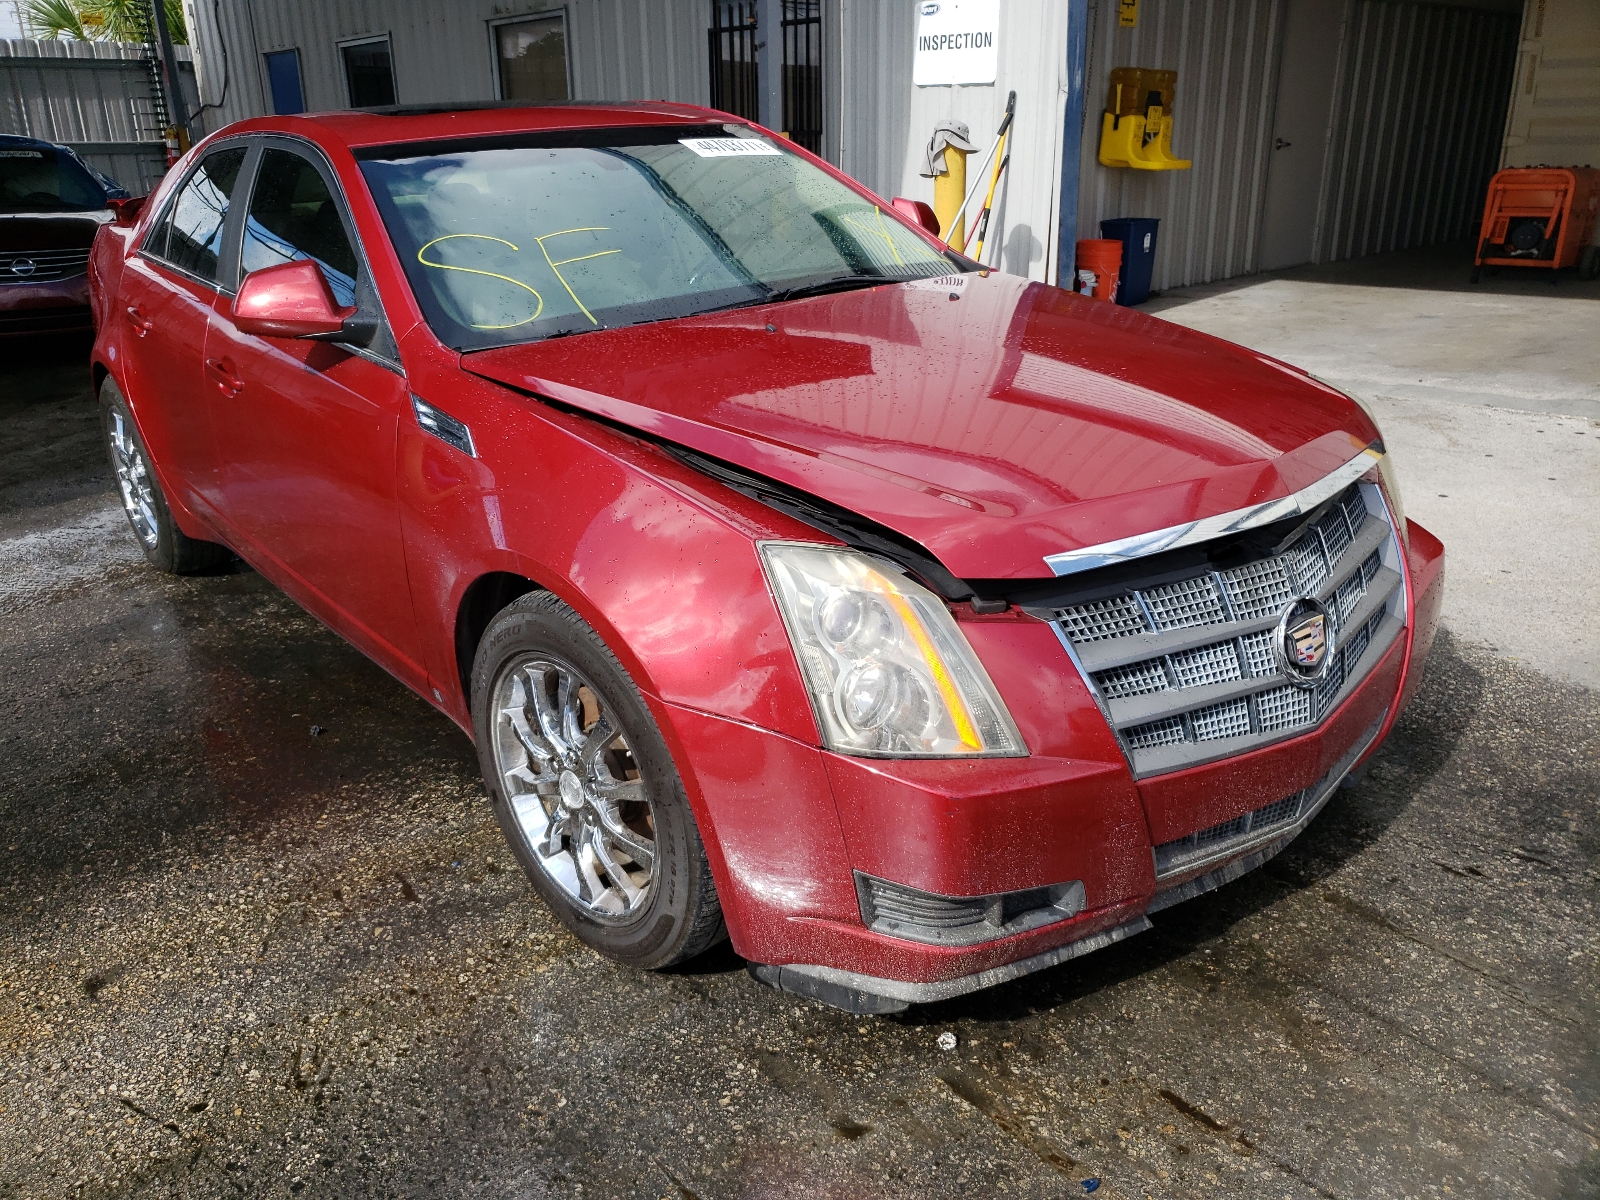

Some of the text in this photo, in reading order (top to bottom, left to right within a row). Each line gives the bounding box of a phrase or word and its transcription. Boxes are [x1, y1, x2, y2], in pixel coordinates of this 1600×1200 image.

[919, 32, 992, 51] INSPECTION
[417, 227, 622, 329] SF
[489, 624, 522, 651] NERO
